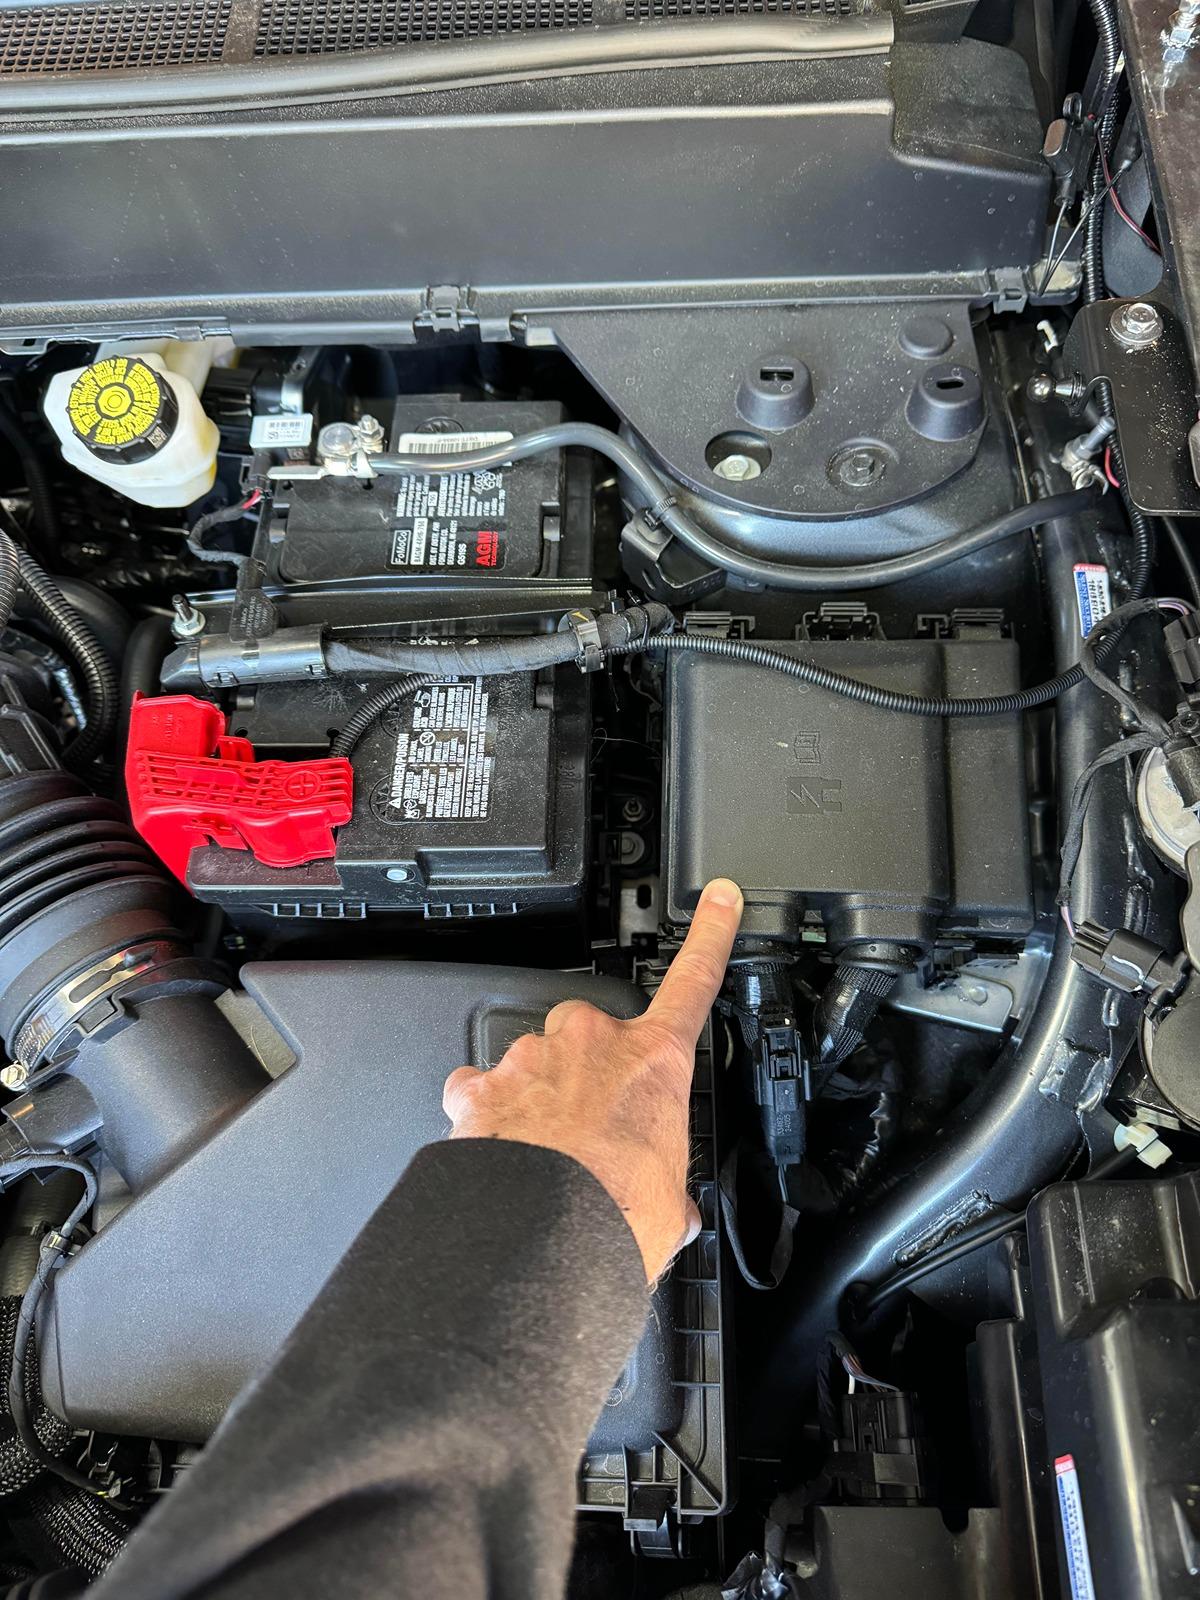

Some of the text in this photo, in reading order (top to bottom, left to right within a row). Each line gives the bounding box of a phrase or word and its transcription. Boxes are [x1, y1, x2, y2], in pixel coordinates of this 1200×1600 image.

[395, 532, 407, 563] FoMoCo
[476, 531, 491, 566] AGM
[391, 734, 409, 797] DANGER/POISON
[472, 804, 480, 817] TENIR
